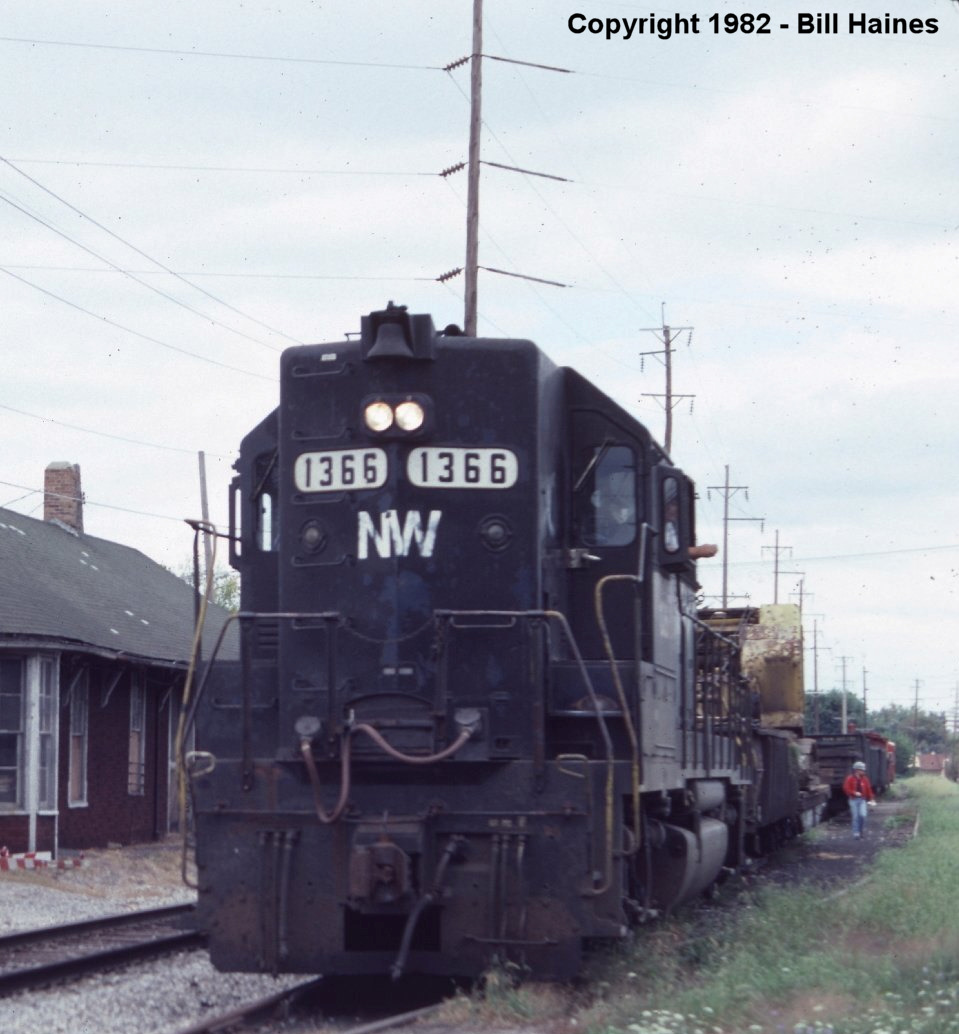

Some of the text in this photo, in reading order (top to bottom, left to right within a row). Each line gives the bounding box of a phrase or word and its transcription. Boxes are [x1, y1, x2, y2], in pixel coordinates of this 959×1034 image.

[304, 453, 378, 488] 1366
[419, 450, 507, 484] 1366
[357, 509, 442, 560] NW
